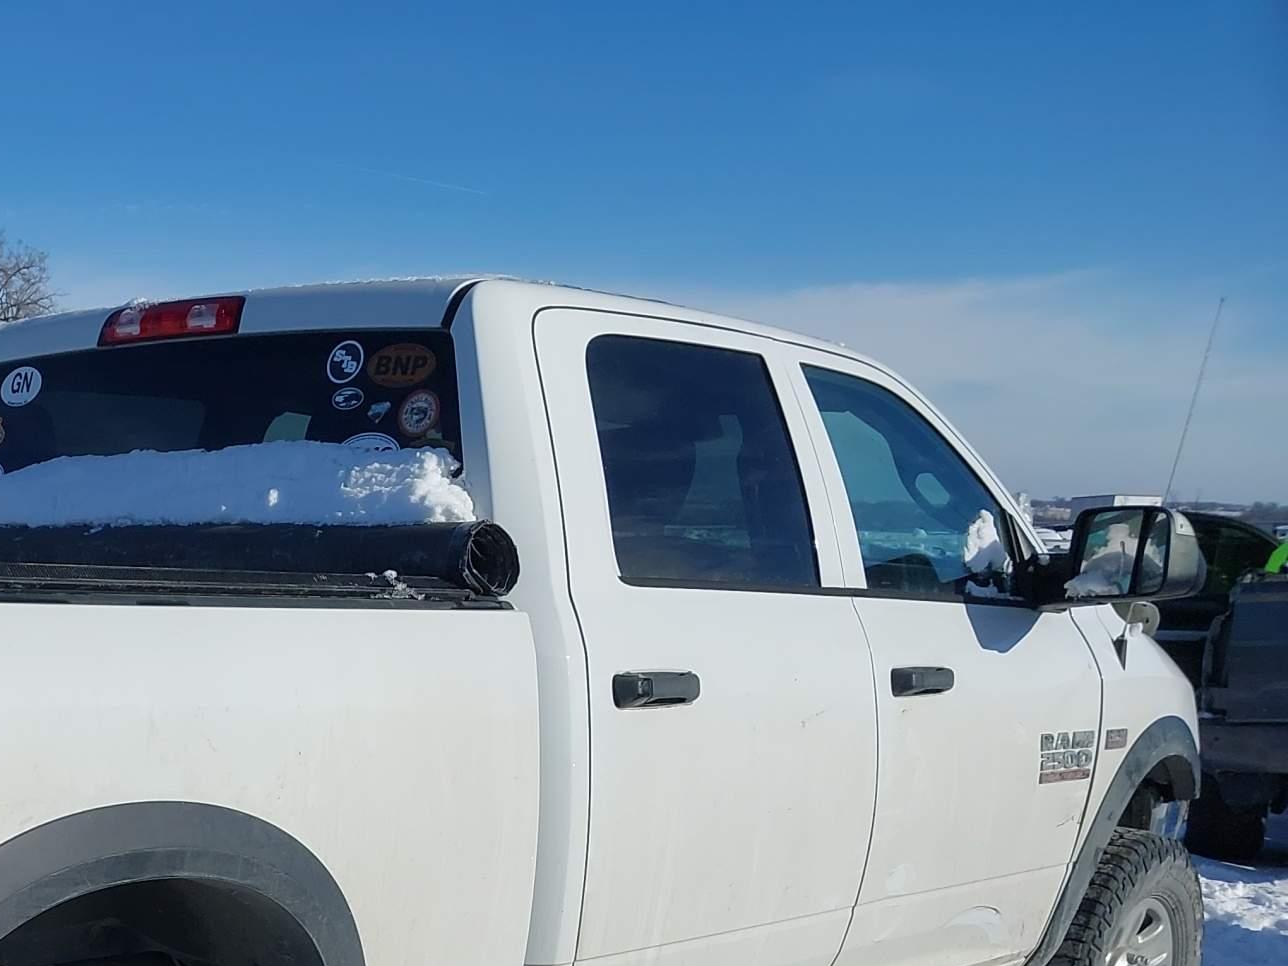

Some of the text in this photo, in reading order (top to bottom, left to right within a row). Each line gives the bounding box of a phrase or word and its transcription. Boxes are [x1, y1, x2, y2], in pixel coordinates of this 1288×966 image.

[373, 354, 429, 377] BNP
[11, 371, 34, 394] GN
[1040, 729, 1095, 752] RAM
[1039, 749, 1094, 772] 2500
